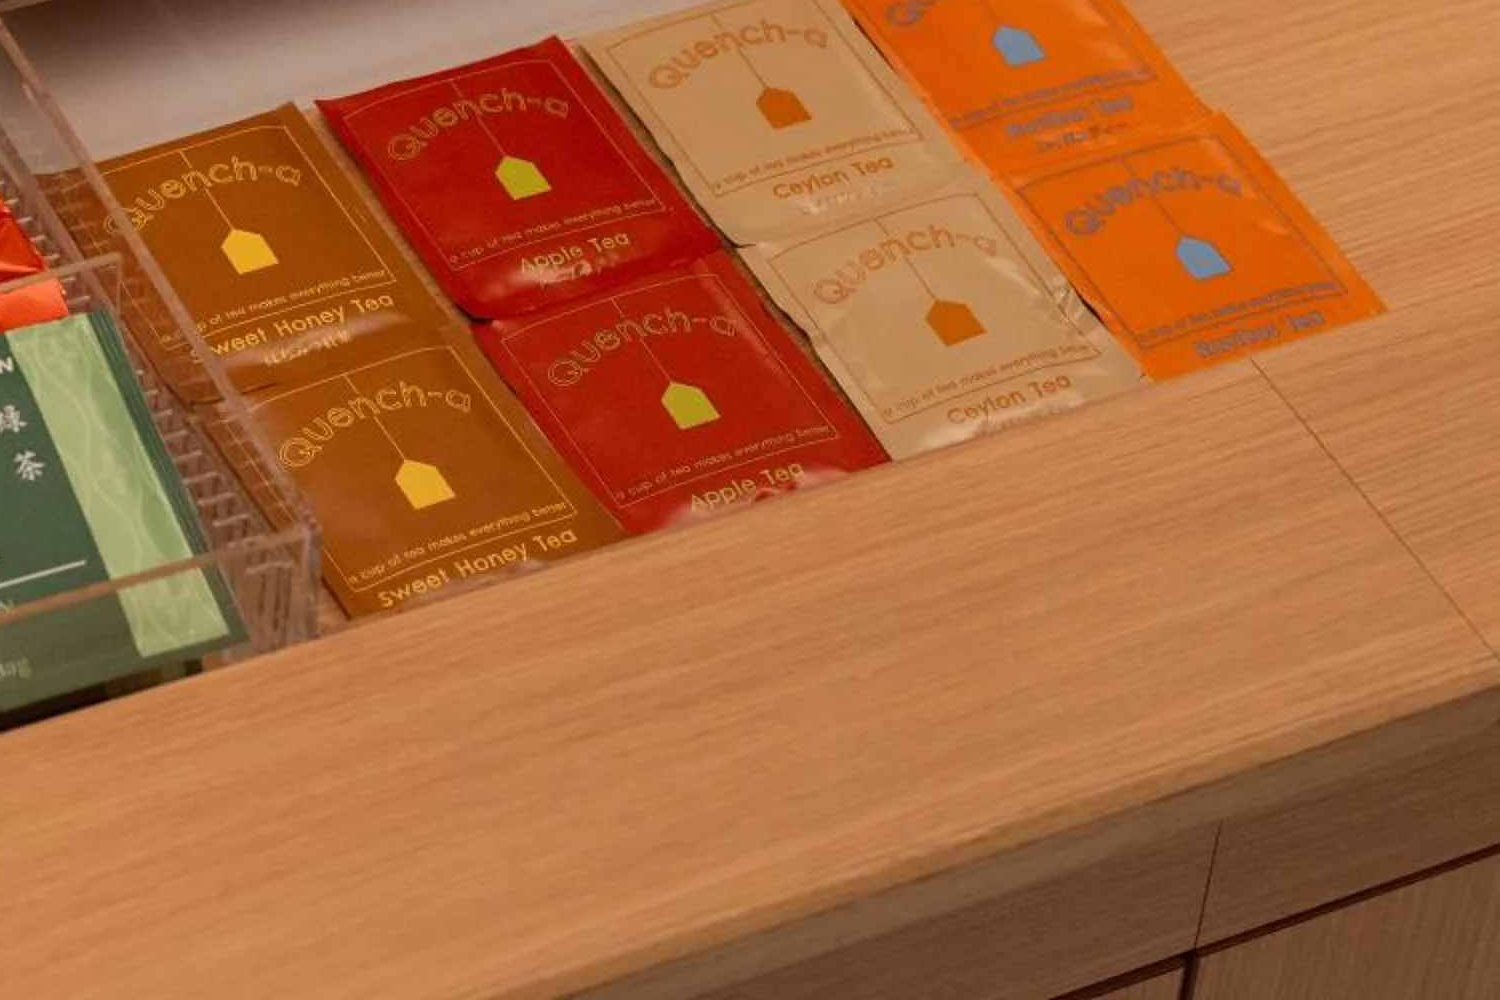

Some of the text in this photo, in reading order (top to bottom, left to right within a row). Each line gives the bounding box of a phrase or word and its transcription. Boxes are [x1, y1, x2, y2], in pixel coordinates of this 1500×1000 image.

[649, 19, 828, 90] Quench-a
[388, 87, 569, 161] Quench-a
[103, 155, 302, 235] Quench-a
[772, 157, 893, 200] Ceylon Tea
[518, 246, 584, 276] Apple
[589, 231, 630, 254] Tea
[814, 225, 998, 304] Quench-a
[275, 305, 346, 337] Honey
[350, 293, 394, 313] Tea
[547, 308, 737, 387] Quench-a
[279, 381, 472, 471] Quench-a
[947, 373, 1072, 425] Ceylon Tea
[626, 480, 653, 499] cup
[654, 470, 668, 482] of
[669, 462, 691, 478] tea
[689, 461, 806, 512] Apple Tea
[359, 563, 386, 583] cup
[387, 553, 402, 567] of
[403, 545, 426, 561] tea
[427, 531, 468, 552] makes
[469, 512, 531, 538] everything
[377, 528, 579, 609] Sweet Honey Tea
